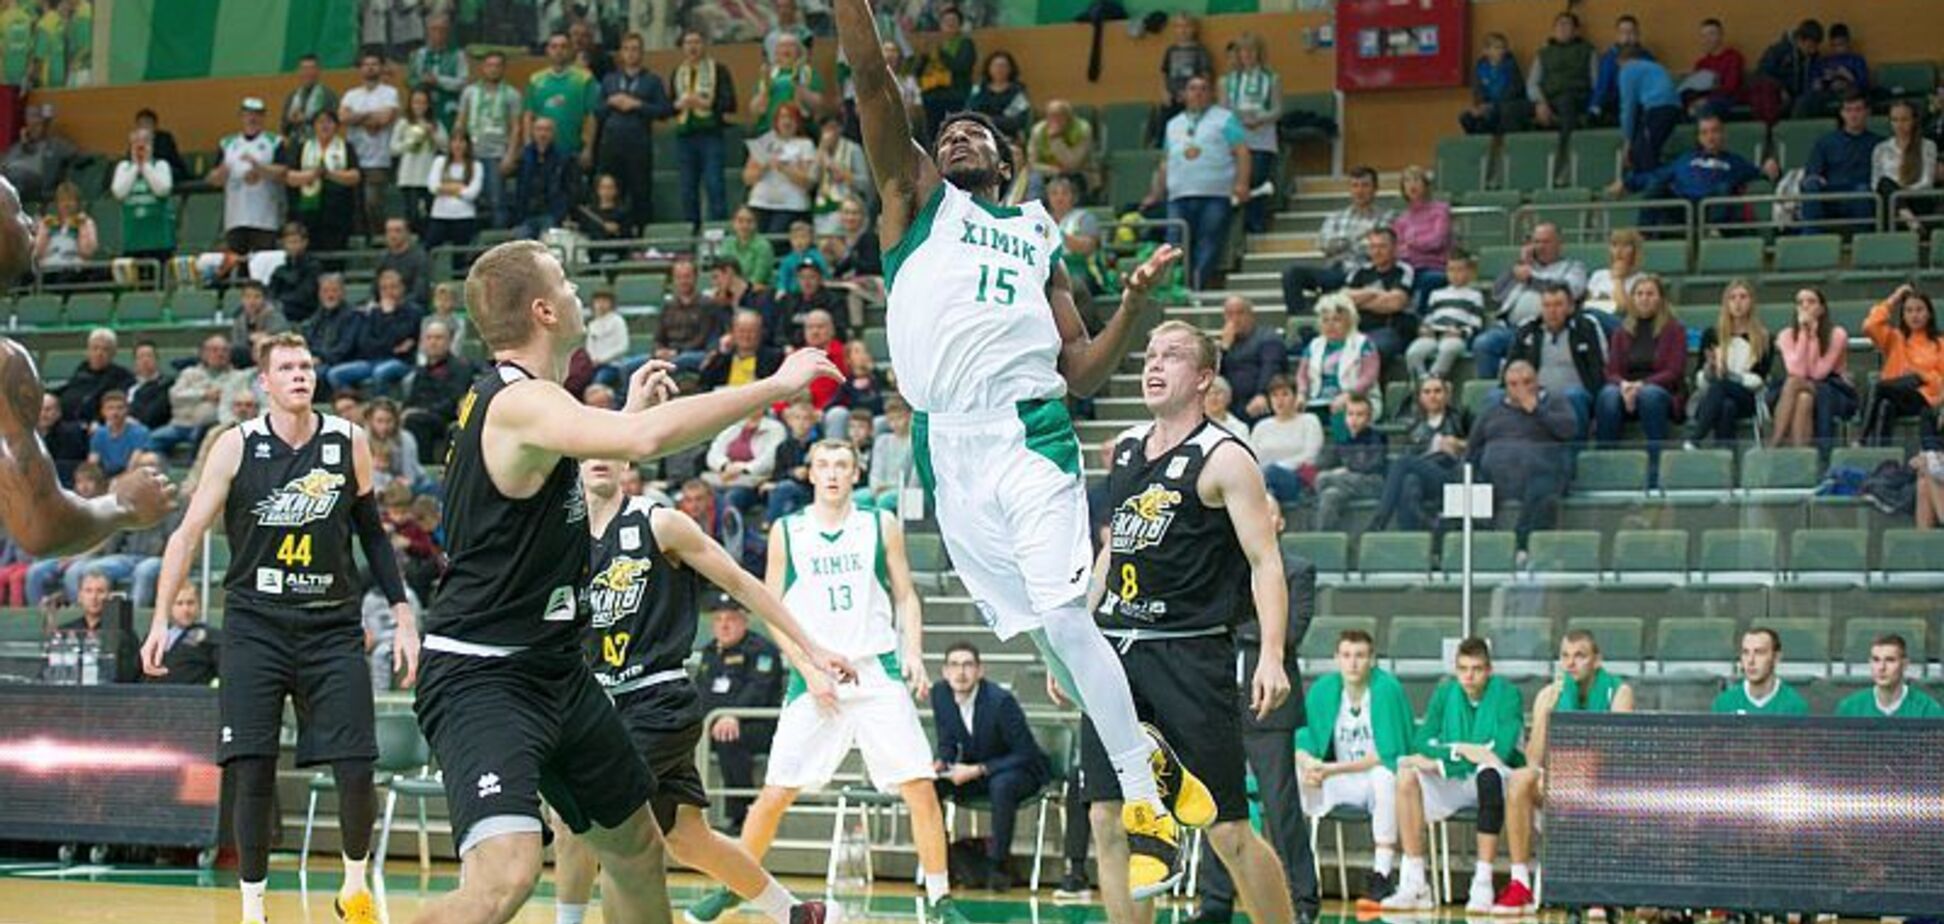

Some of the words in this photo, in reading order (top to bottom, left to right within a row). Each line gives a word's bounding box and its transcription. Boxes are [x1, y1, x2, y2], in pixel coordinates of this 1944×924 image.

[976, 264, 1018, 305] 15
[277, 534, 312, 567] 44
[828, 584, 853, 612] 13
[1121, 563, 1138, 602] 8
